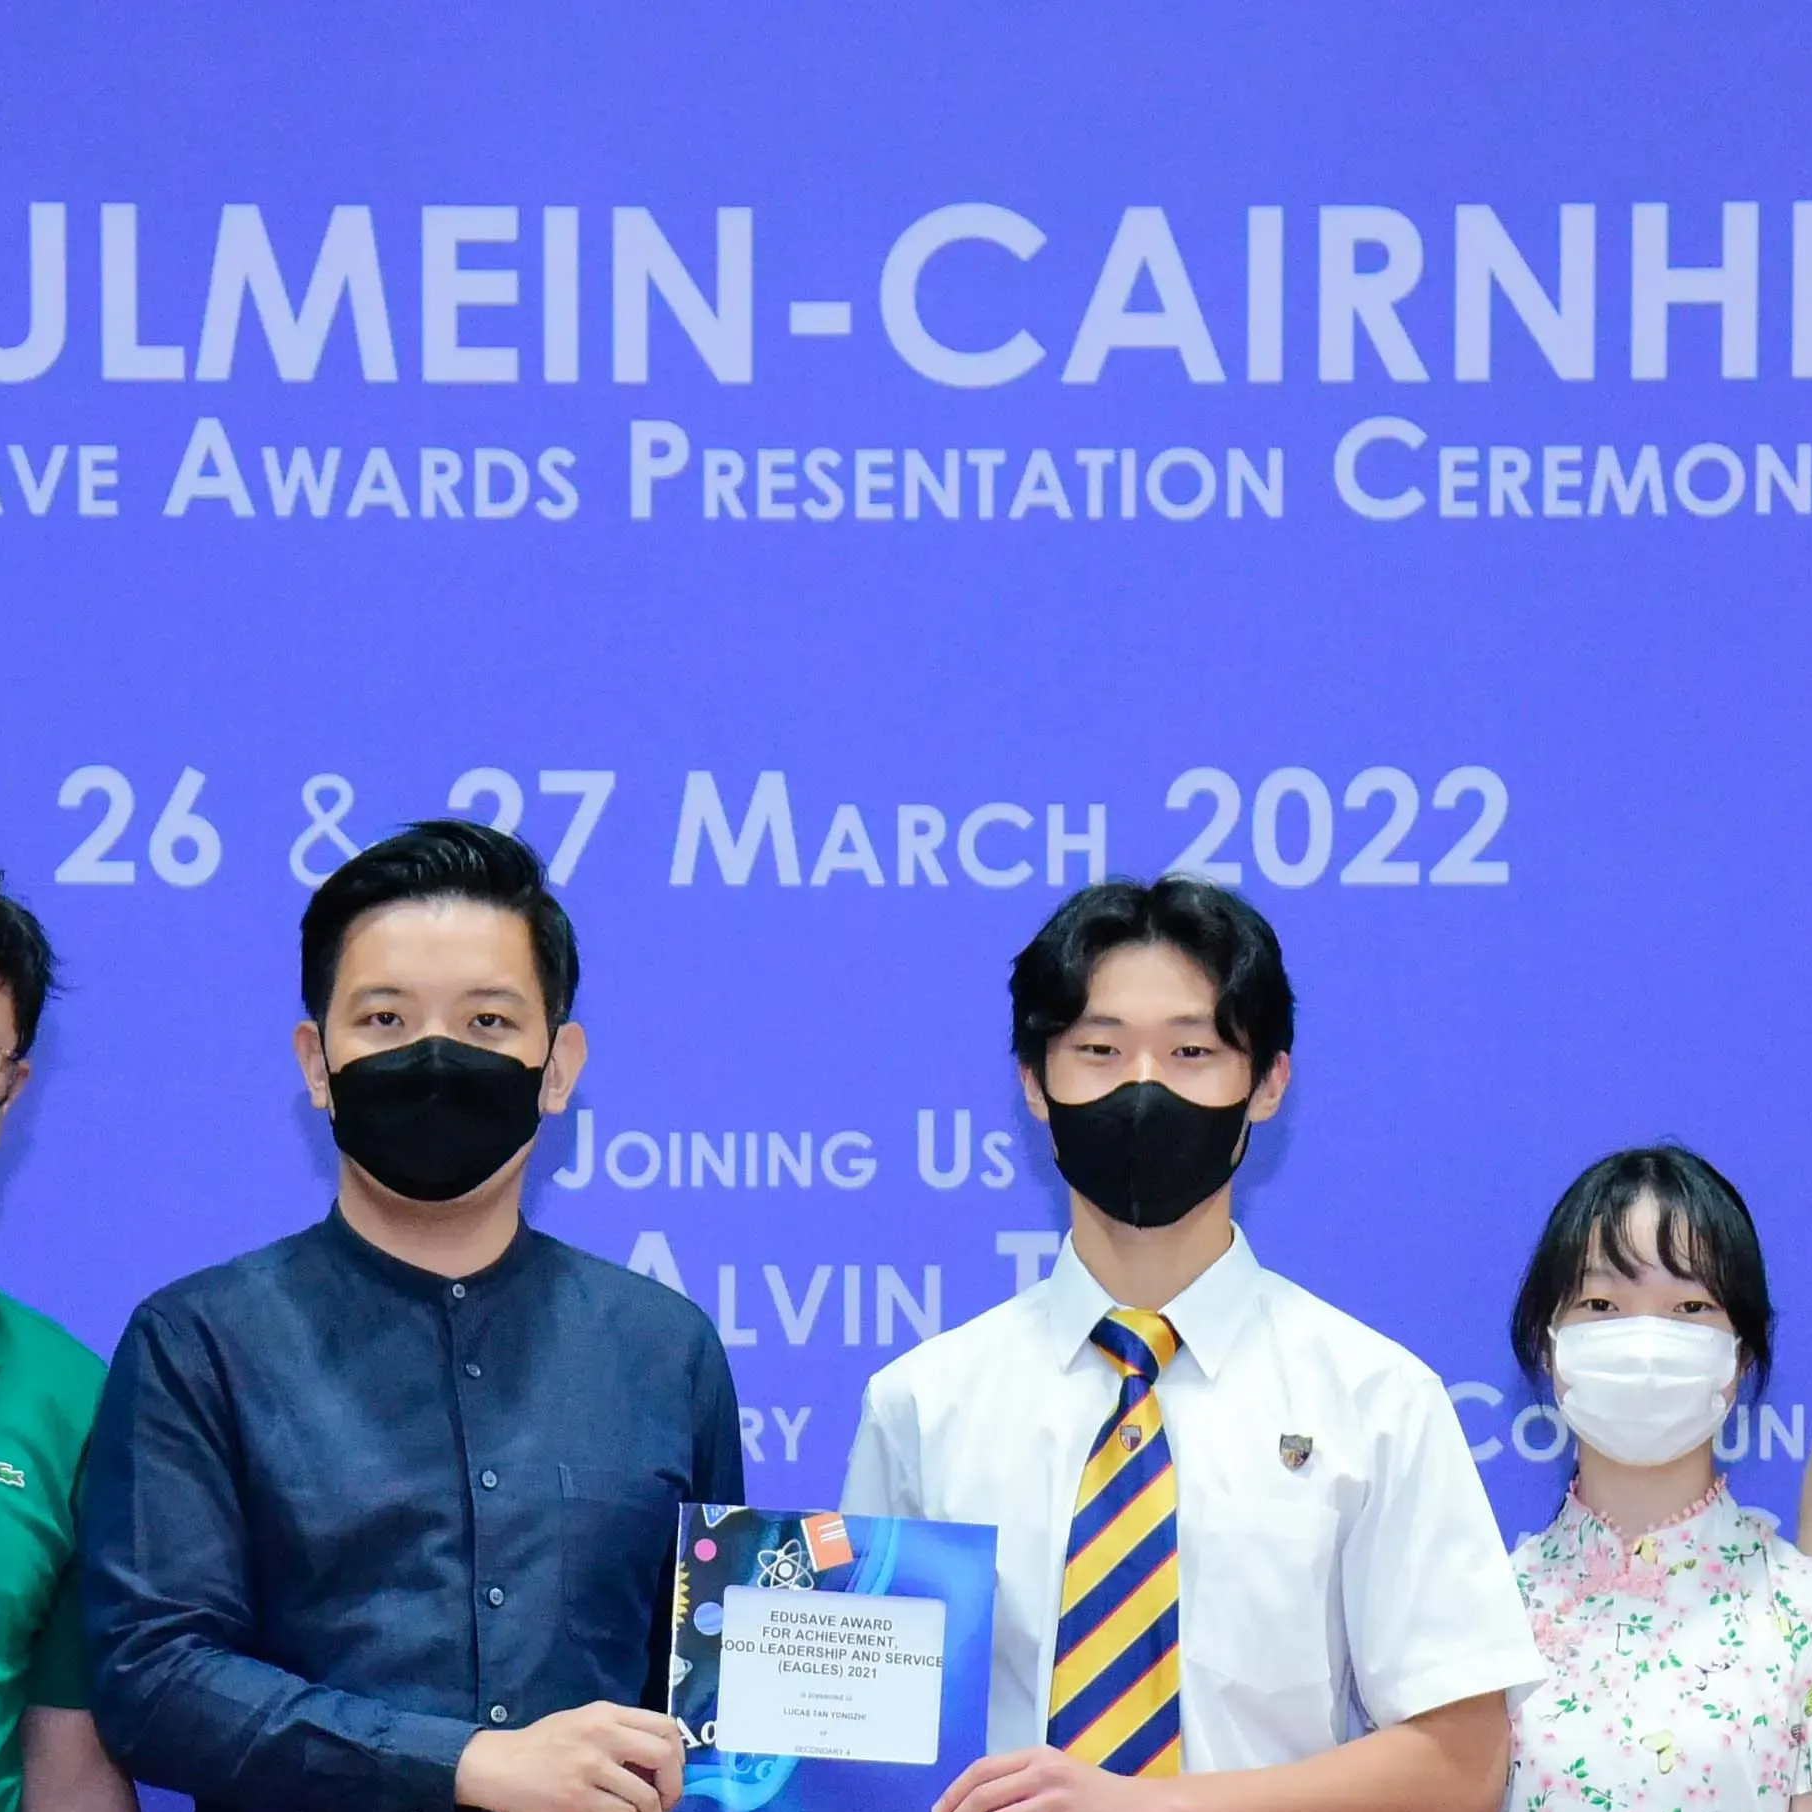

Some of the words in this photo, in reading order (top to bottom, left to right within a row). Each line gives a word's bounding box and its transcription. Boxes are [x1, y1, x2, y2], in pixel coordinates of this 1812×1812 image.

[162, 417, 579, 521] AWARDS
[630, 420, 1283, 521] PRESENTATION
[54, 765, 222, 887] 26
[668, 770, 1107, 888] MARCH
[1163, 765, 1509, 888] 2022
[552, 1109, 877, 1190] JOINING
[917, 1109, 1015, 1190] US
[770, 1610, 837, 1627] EDUSAVE
[840, 1615, 893, 1632] AWARD
[762, 1626, 791, 1640] FOR
[795, 1629, 898, 1649] ACHIEVEMENT,
[721, 1639, 755, 1652] OOD
[760, 1643, 847, 1660] LEADERSHIP
[852, 1650, 881, 1664] AND
[885, 1652, 944, 1668] SERVICE
[778, 1660, 844, 1678] (EAGLES)
[848, 1666, 878, 1679] 2021
[783, 1707, 811, 1718] LUCAS
[813, 1709, 829, 1719] TAN
